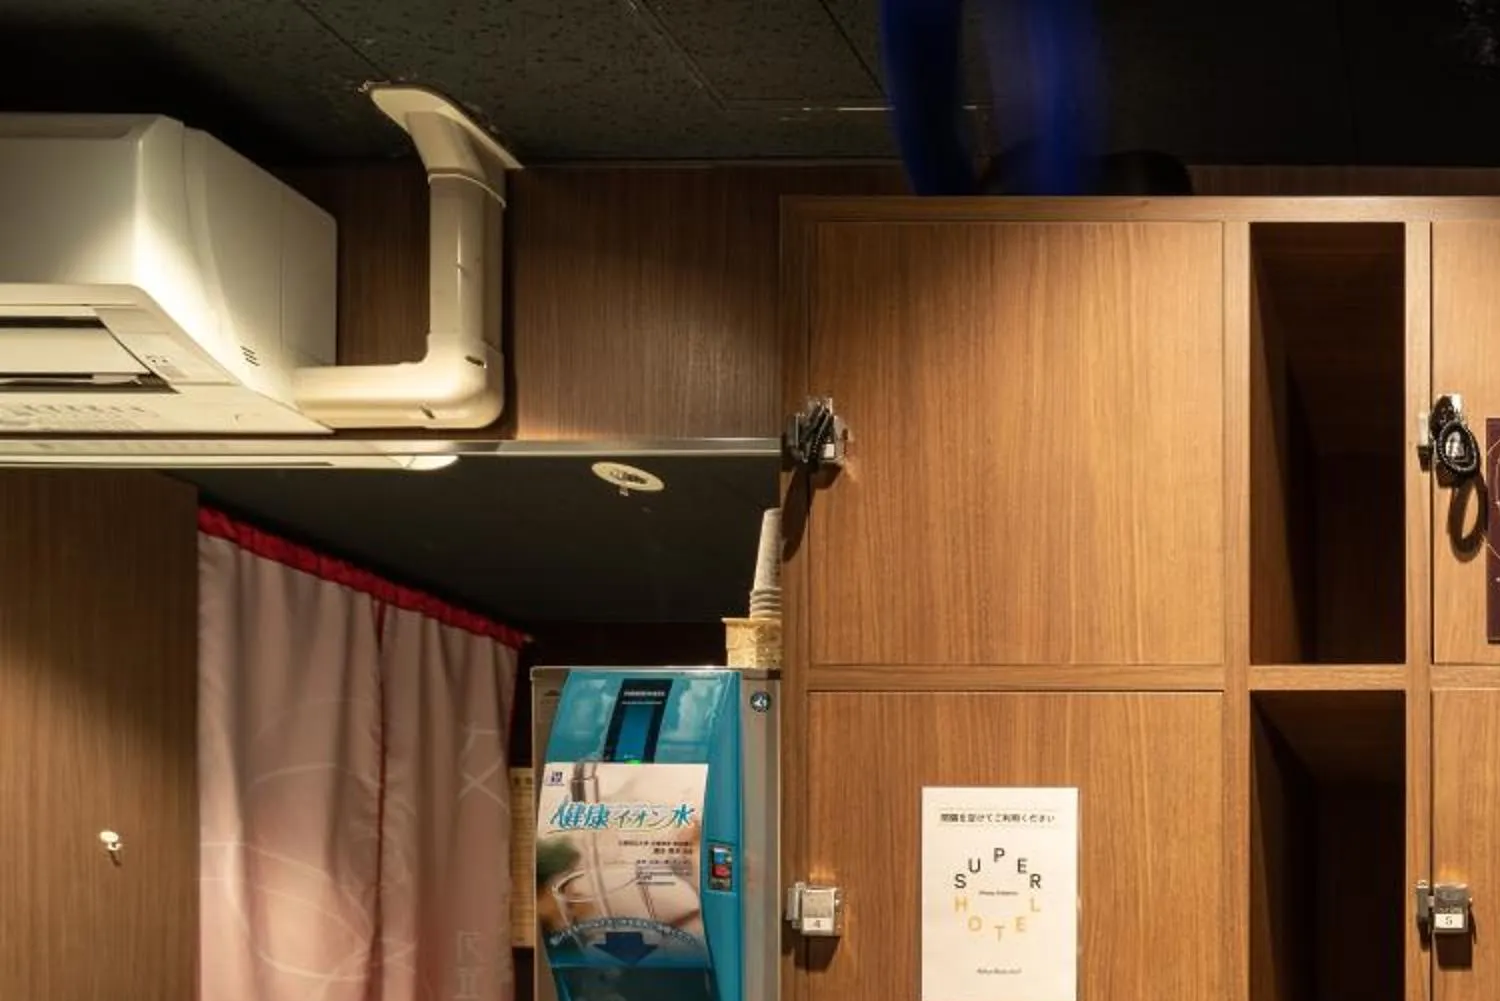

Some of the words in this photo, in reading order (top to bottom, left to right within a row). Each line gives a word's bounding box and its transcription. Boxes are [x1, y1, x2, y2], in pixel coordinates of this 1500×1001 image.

[550, 796, 696, 829] 健康イオン水
[954, 847, 1042, 889] SUPER
[954, 896, 1041, 942] HOTEL
